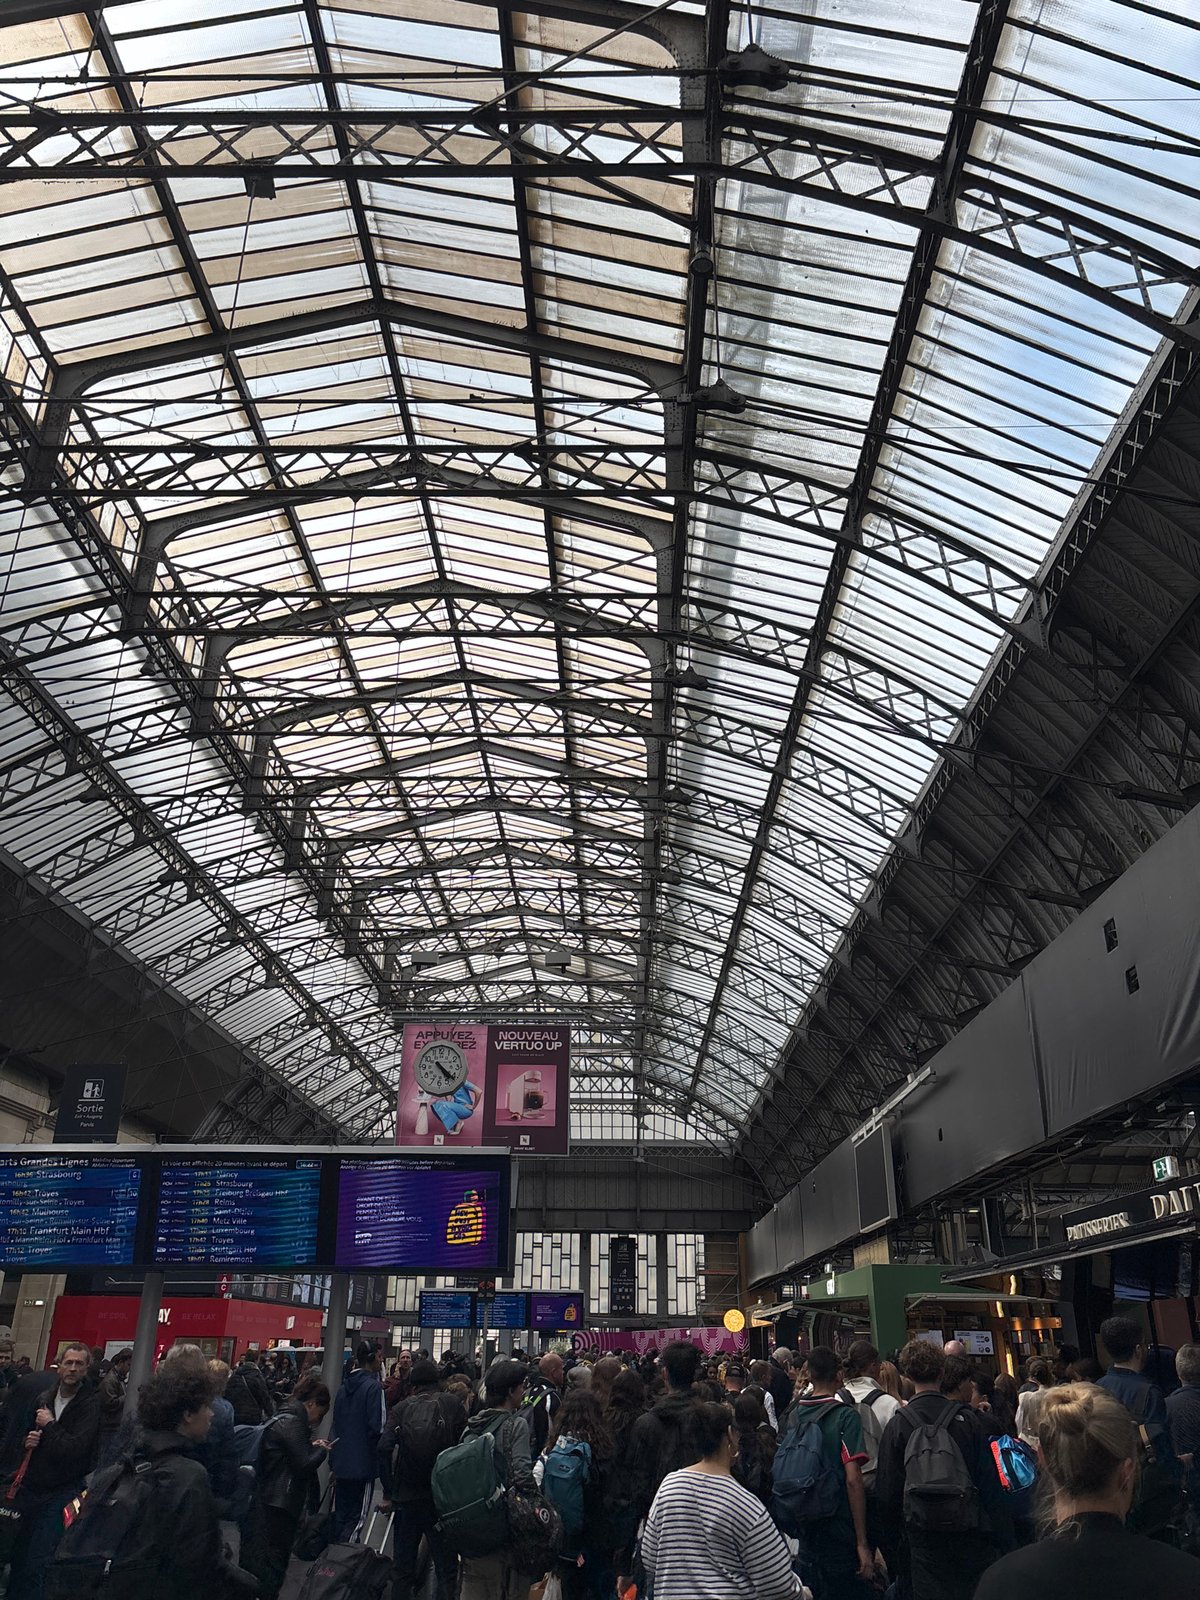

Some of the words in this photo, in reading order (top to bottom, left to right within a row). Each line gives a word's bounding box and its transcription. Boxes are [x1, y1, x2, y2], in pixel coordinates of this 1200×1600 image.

[415, 1031, 477, 1041] APPUYEZ,
[498, 1031, 559, 1040] NOUVEAU
[494, 1041, 544, 1050] VERTUO
[546, 1041, 563, 1050] UP
[76, 1103, 104, 1113] Sortie
[20, 1157, 58, 1167] Grandes
[60, 1157, 89, 1169] Lignes
[36, 1170, 82, 1181] Strasbourg
[216, 1170, 240, 1179] Nancy
[215, 1180, 253, 1189] Strasbourg
[34, 1189, 59, 1198] Troyes
[214, 1189, 244, 1198] Freiburg
[214, 1198, 236, 1206] Reims
[32, 1207, 69, 1217] Mulhouse
[212, 1216, 231, 1225] Metz
[231, 1216, 248, 1225] Ville
[30, 1226, 70, 1235] Frankfurt
[70, 1226, 92, 1235] Main
[93, 1226, 111, 1235] Hbf
[211, 1226, 256, 1236] Luxembourg
[211, 1235, 234, 1245] Troyes
[28, 1246, 53, 1256] Troyes
[210, 1245, 242, 1255] Stuttgart
[209, 1254, 253, 1263] Remiremont
